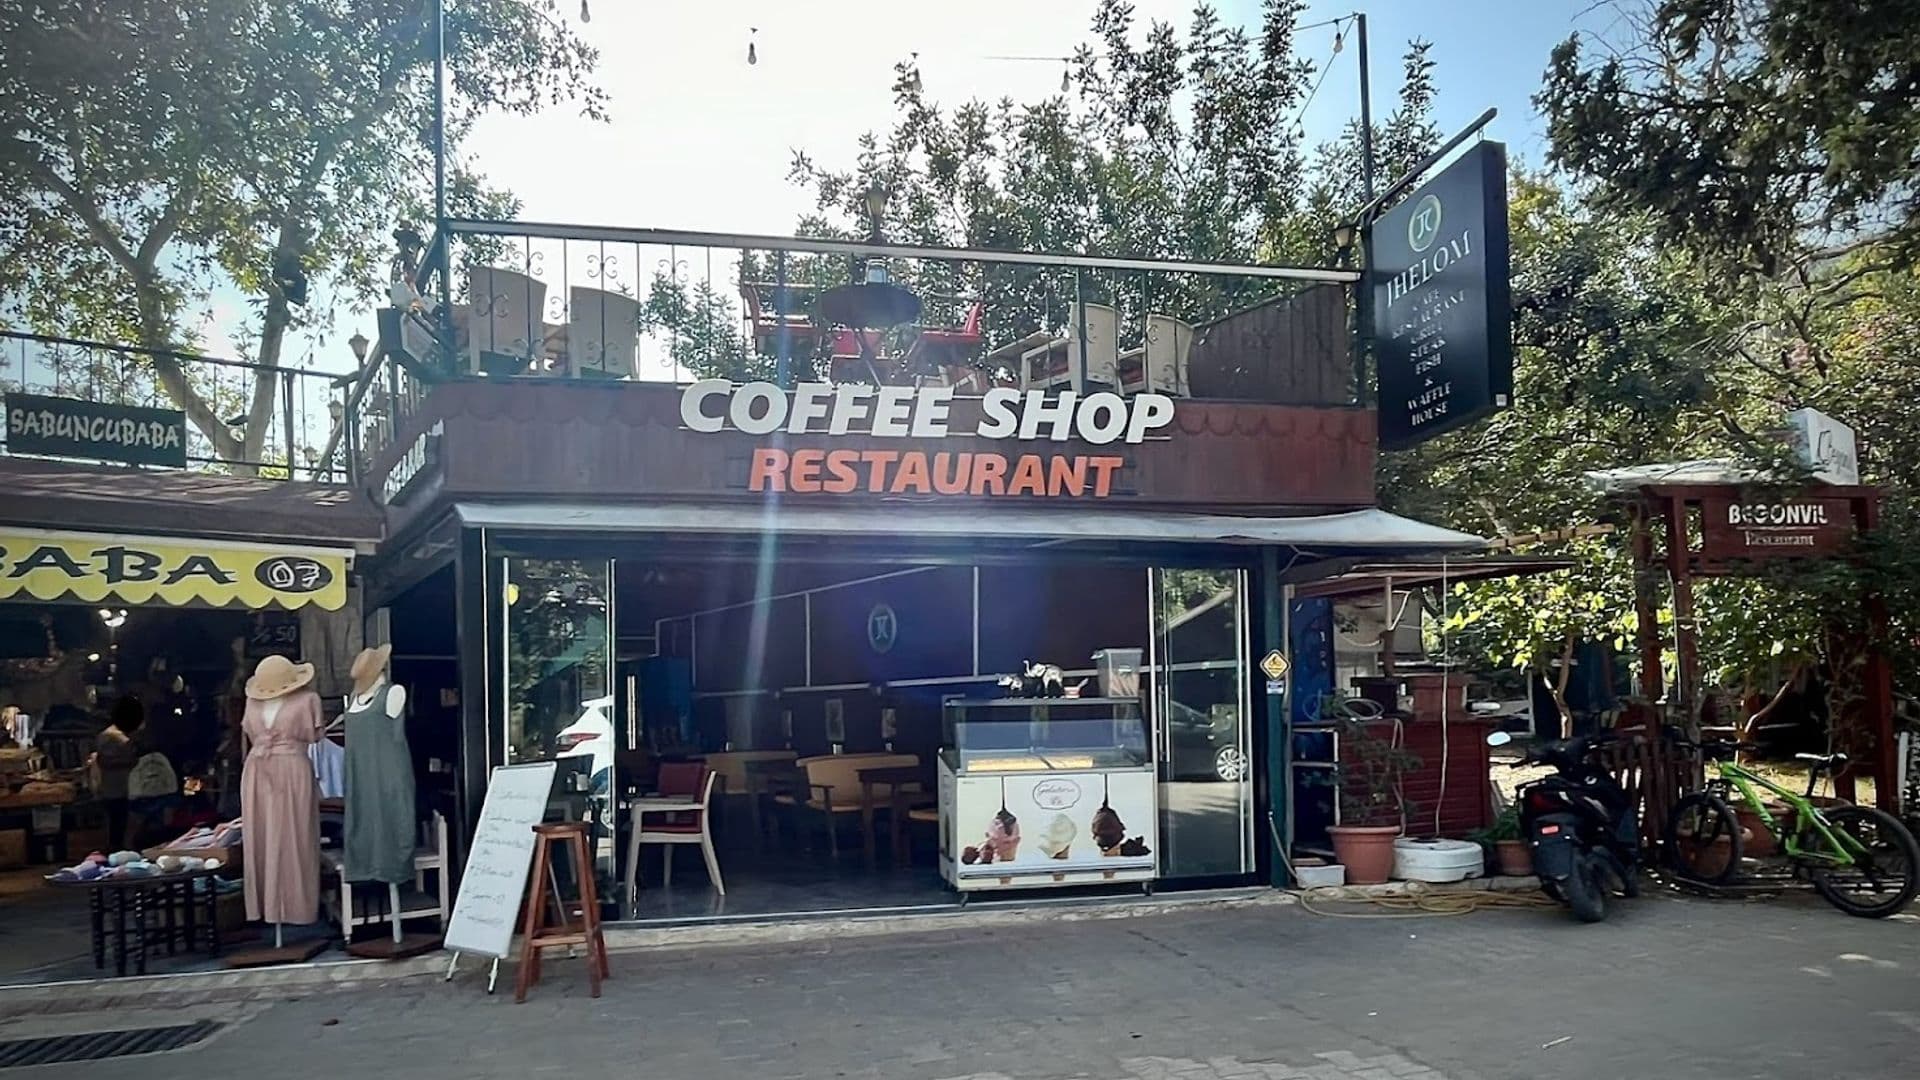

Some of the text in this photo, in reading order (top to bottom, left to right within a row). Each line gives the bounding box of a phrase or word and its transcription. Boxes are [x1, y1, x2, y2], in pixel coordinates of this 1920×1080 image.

[10, 407, 180, 450] SABUNCUBABA
[679, 377, 1175, 444] COFFEE SHOP
[748, 448, 1124, 498] RESTAURANT
[0, 545, 239, 585] ABA
